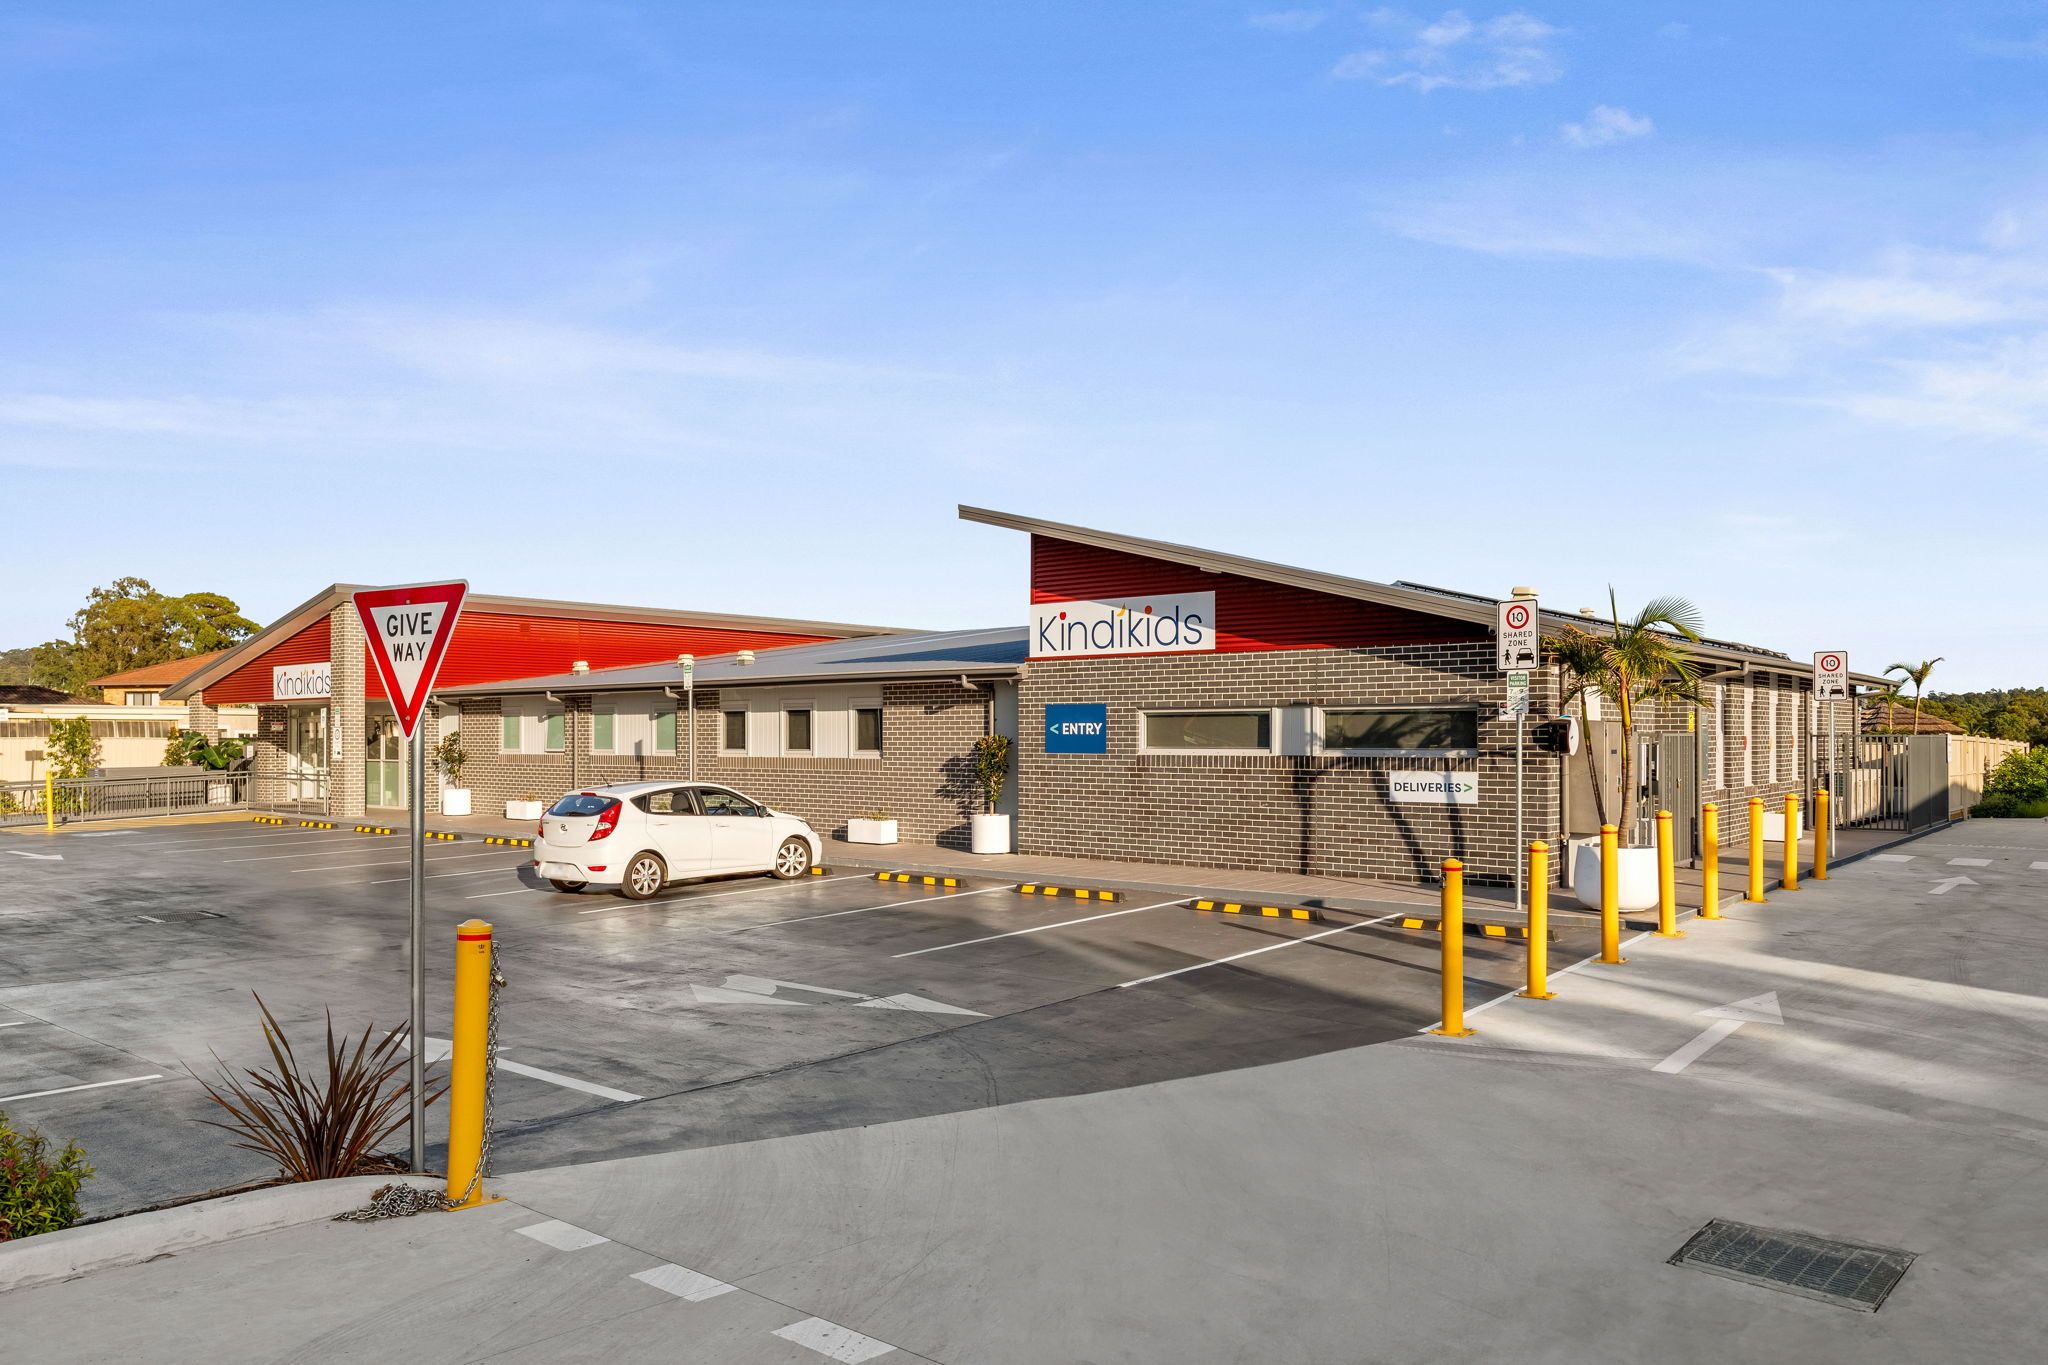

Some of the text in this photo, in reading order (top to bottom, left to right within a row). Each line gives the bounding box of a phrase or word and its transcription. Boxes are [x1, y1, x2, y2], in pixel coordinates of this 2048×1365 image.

[1512, 611, 1524, 623] 10
[386, 612, 433, 637] GIVE
[1039, 602, 1203, 652] Kindikids
[1503, 630, 1533, 639] SHARED
[392, 641, 426, 662] WAY
[1825, 659, 1836, 667] 10
[276, 668, 331, 697] Kindikids
[1062, 722, 1103, 735] ENTRY
[1394, 782, 1462, 792] DELIVERIES
